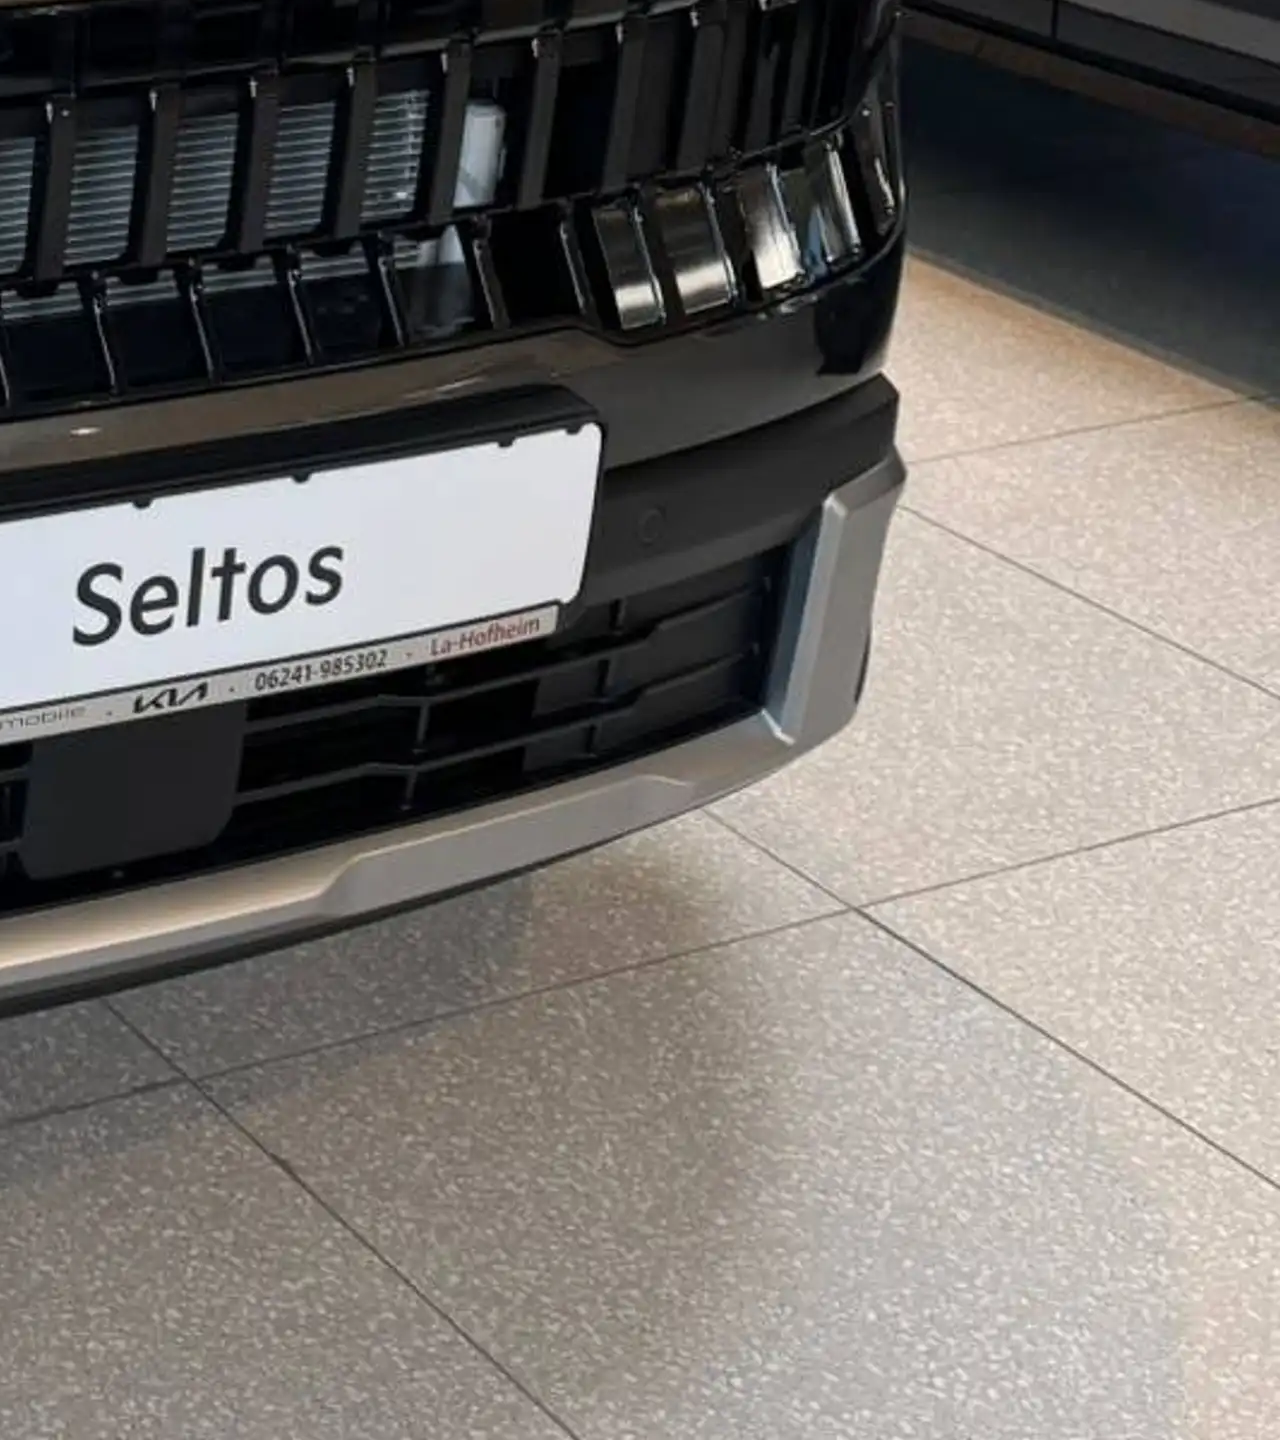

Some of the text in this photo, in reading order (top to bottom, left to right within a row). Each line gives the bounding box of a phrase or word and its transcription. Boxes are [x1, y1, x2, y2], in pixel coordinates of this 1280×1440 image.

[72, 544, 345, 648] Seltos
[132, 681, 209, 715] KIA
[254, 649, 388, 692] 06241-985302
[430, 617, 541, 658] La-Hofheim
